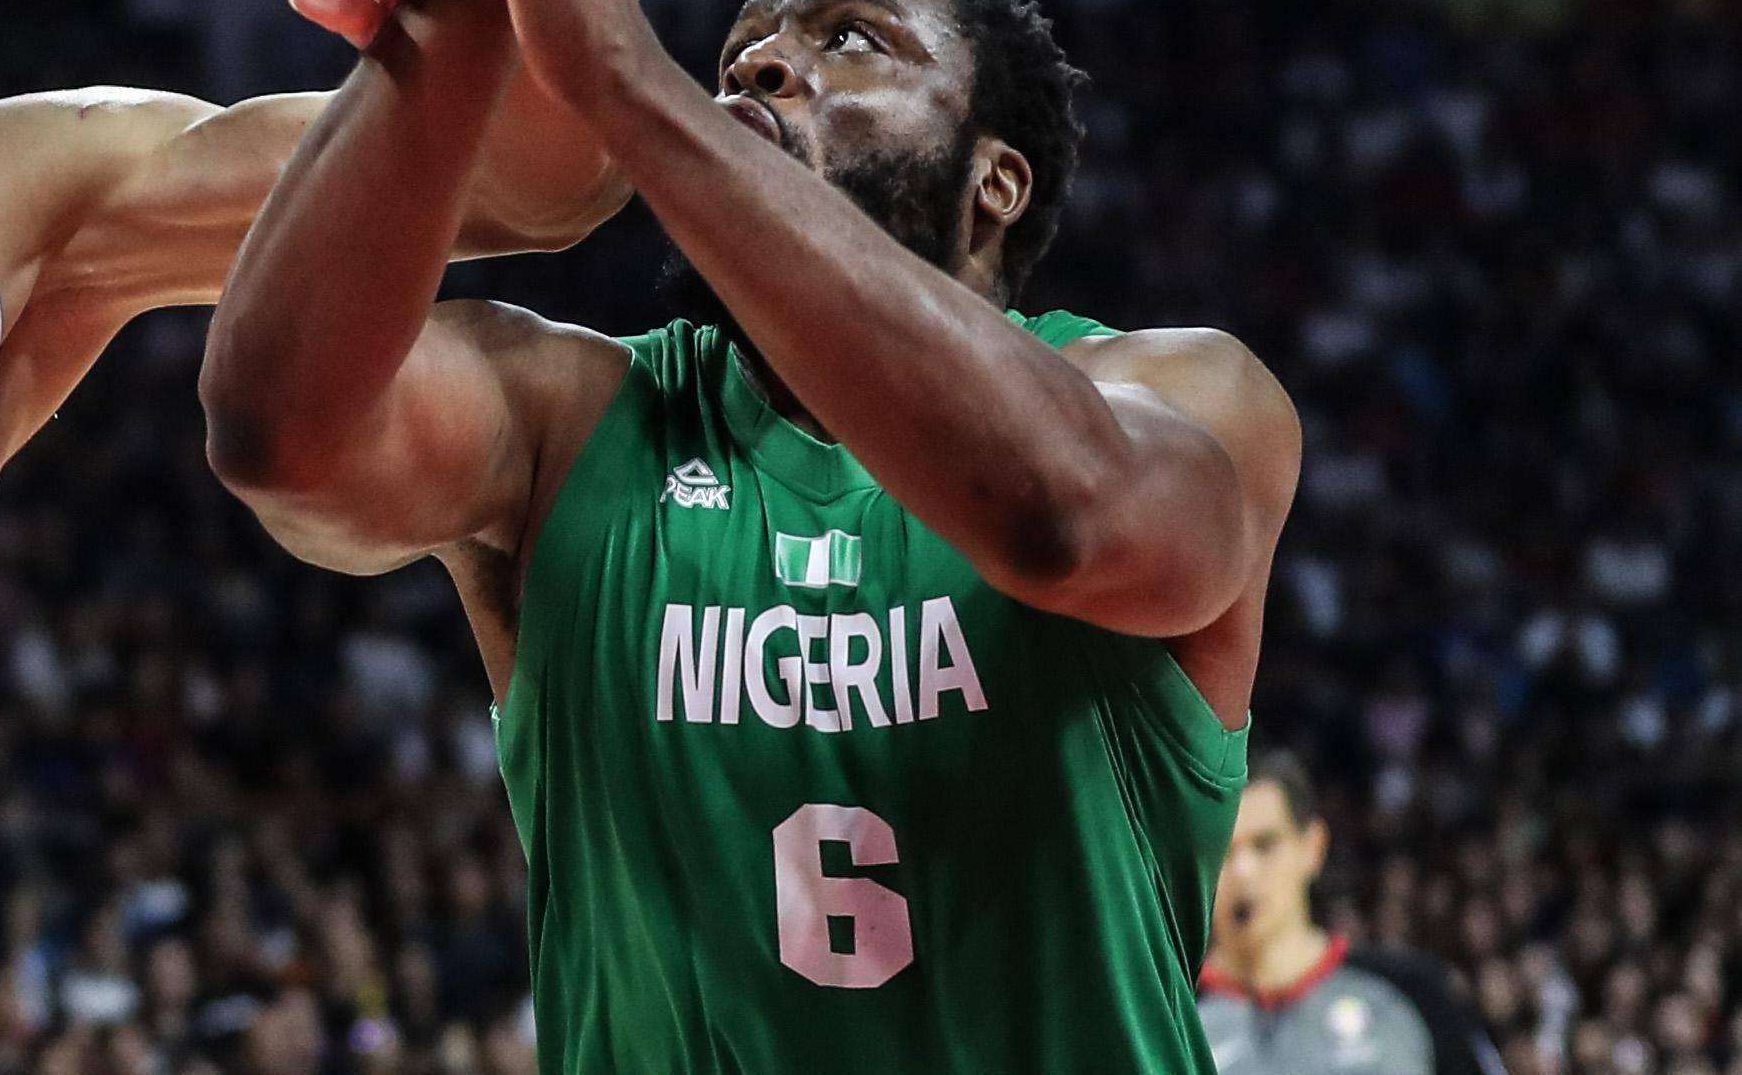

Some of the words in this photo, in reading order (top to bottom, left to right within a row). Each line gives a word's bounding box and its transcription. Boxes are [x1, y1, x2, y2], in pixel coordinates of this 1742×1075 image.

[659, 474, 732, 510] PEAK
[656, 596, 989, 733] NIGERIA
[772, 803, 915, 989] 6
